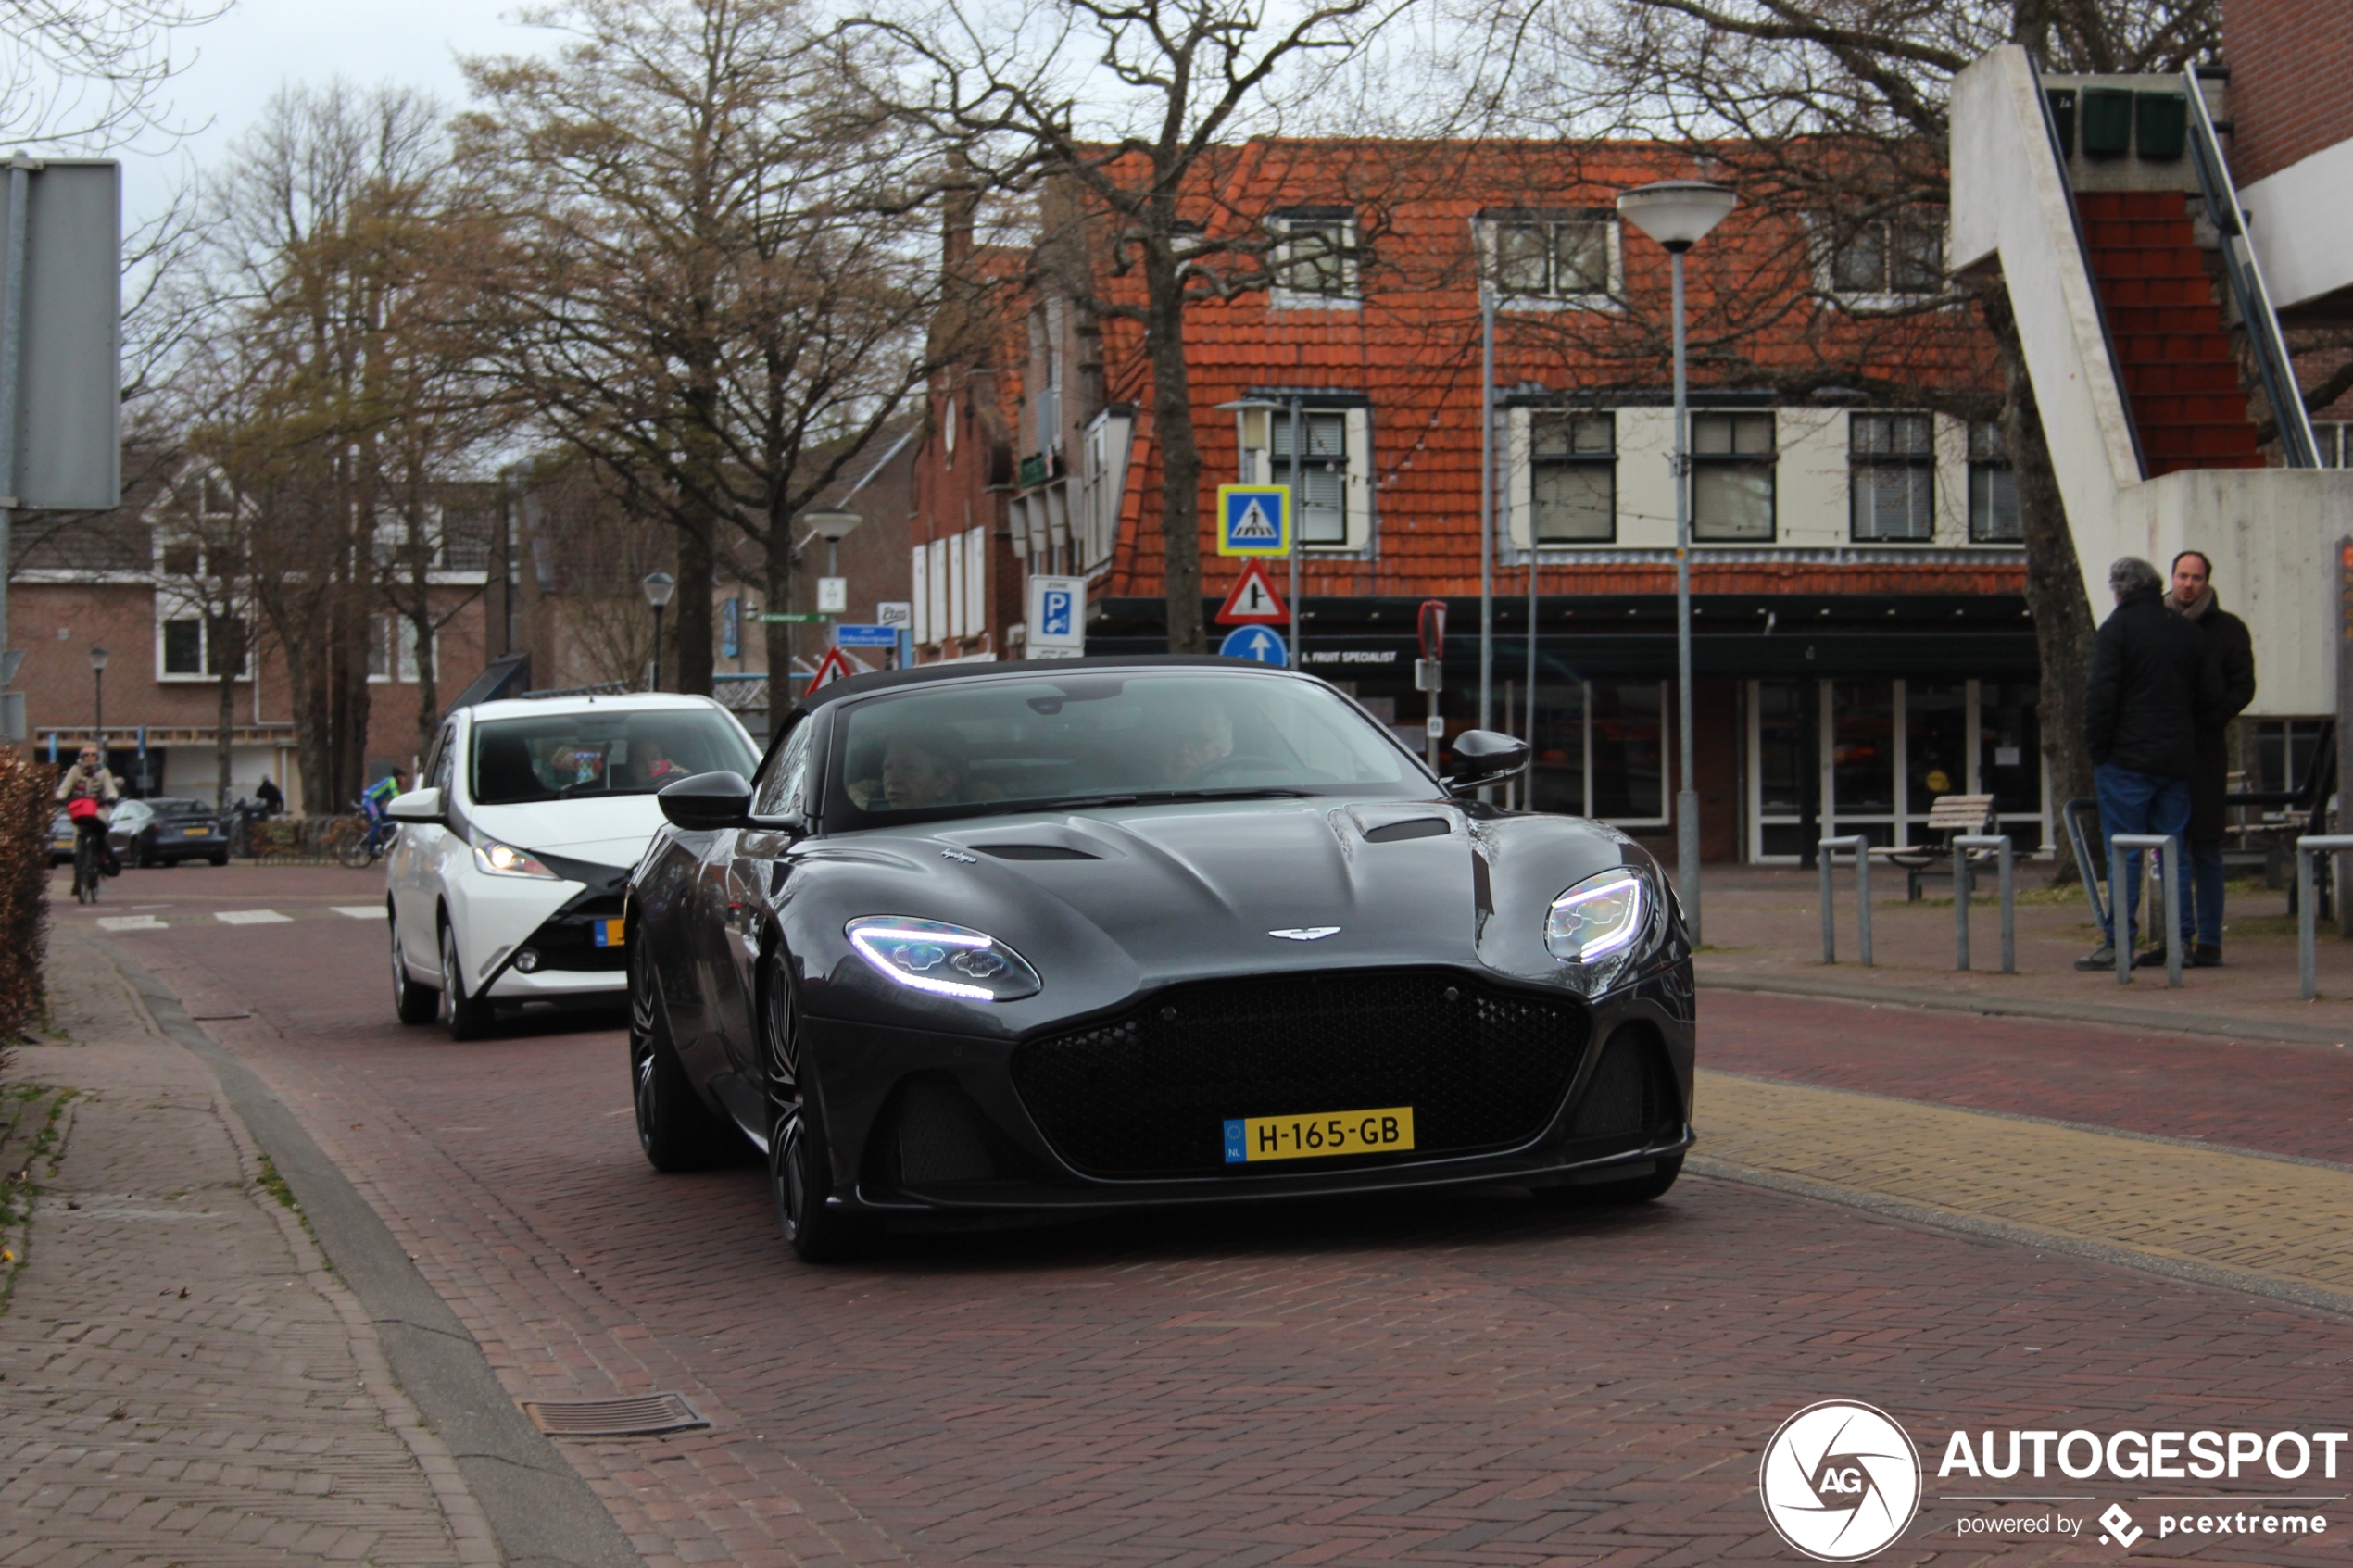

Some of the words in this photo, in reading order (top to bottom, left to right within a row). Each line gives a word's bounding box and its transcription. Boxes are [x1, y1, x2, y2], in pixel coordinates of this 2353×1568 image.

[1047, 593, 1067, 618] P
[1312, 651, 1340, 663] FRUIT
[1341, 651, 1397, 663] SPECIALIST
[1258, 1116, 1401, 1153] H-165-GB
[1228, 1148, 1240, 1157] NL
